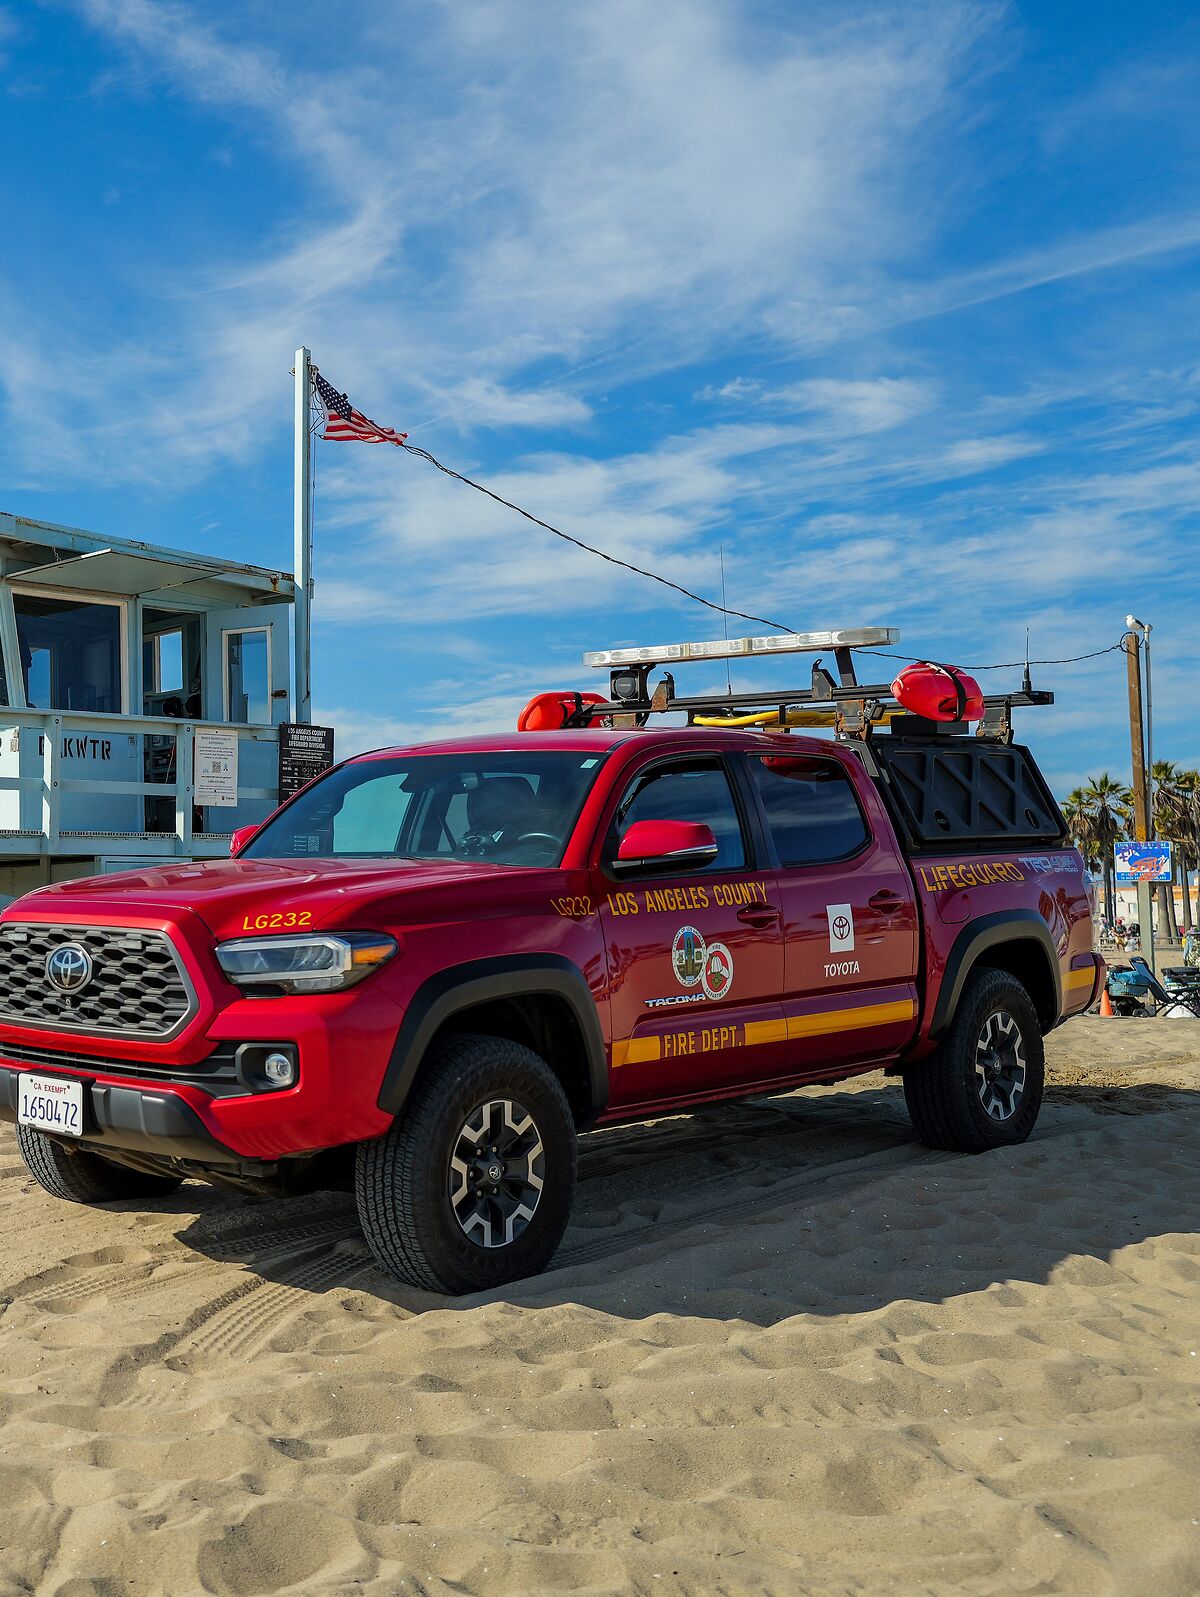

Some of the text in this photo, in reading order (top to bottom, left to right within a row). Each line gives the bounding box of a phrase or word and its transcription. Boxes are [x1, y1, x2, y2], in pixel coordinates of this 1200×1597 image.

[919, 862, 1025, 892] LIFEGUARD
[550, 896, 595, 916] LG232
[606, 881, 768, 916] LOS ANGELES COUNTY
[242, 911, 312, 930] LG232
[823, 960, 860, 978] TOYOTA
[644, 993, 706, 1008] TACOMA
[664, 1025, 742, 1058] FIRE DEPT.
[33, 1082, 67, 1095] CA EXEMPT
[22, 1094, 78, 1128] 1650472
